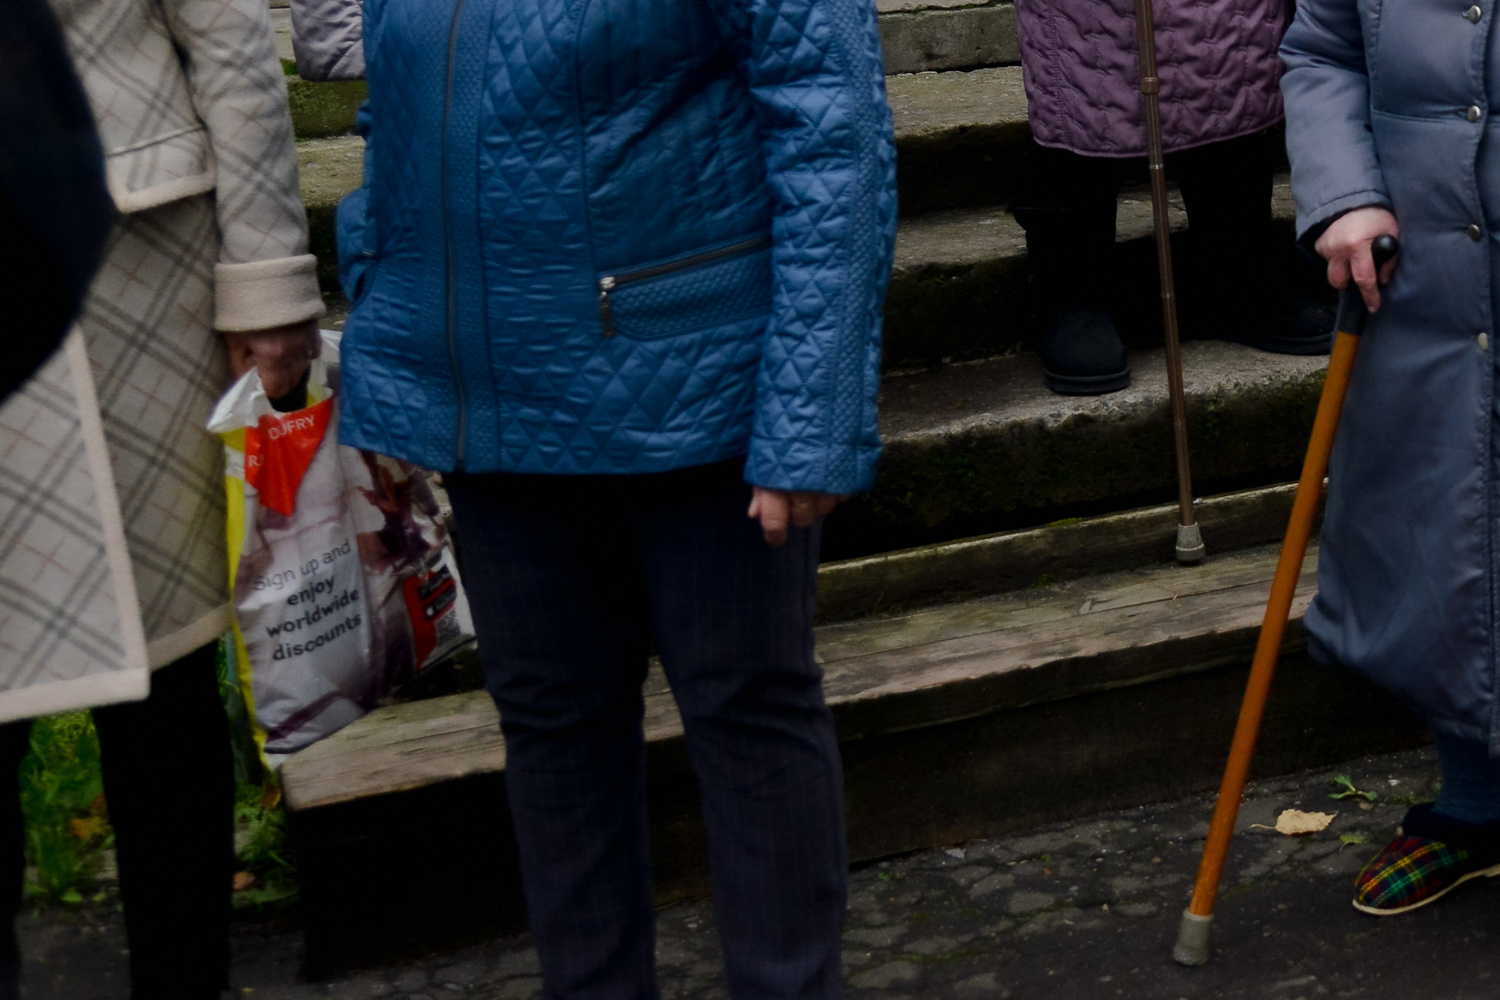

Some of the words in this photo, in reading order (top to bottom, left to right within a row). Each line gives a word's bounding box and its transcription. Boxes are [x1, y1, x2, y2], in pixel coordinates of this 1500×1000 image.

[300, 558, 320, 575] up
[322, 538, 352, 564] and
[286, 575, 335, 606] enjoy
[266, 588, 360, 637] worldwide
[272, 613, 362, 661] discounts
